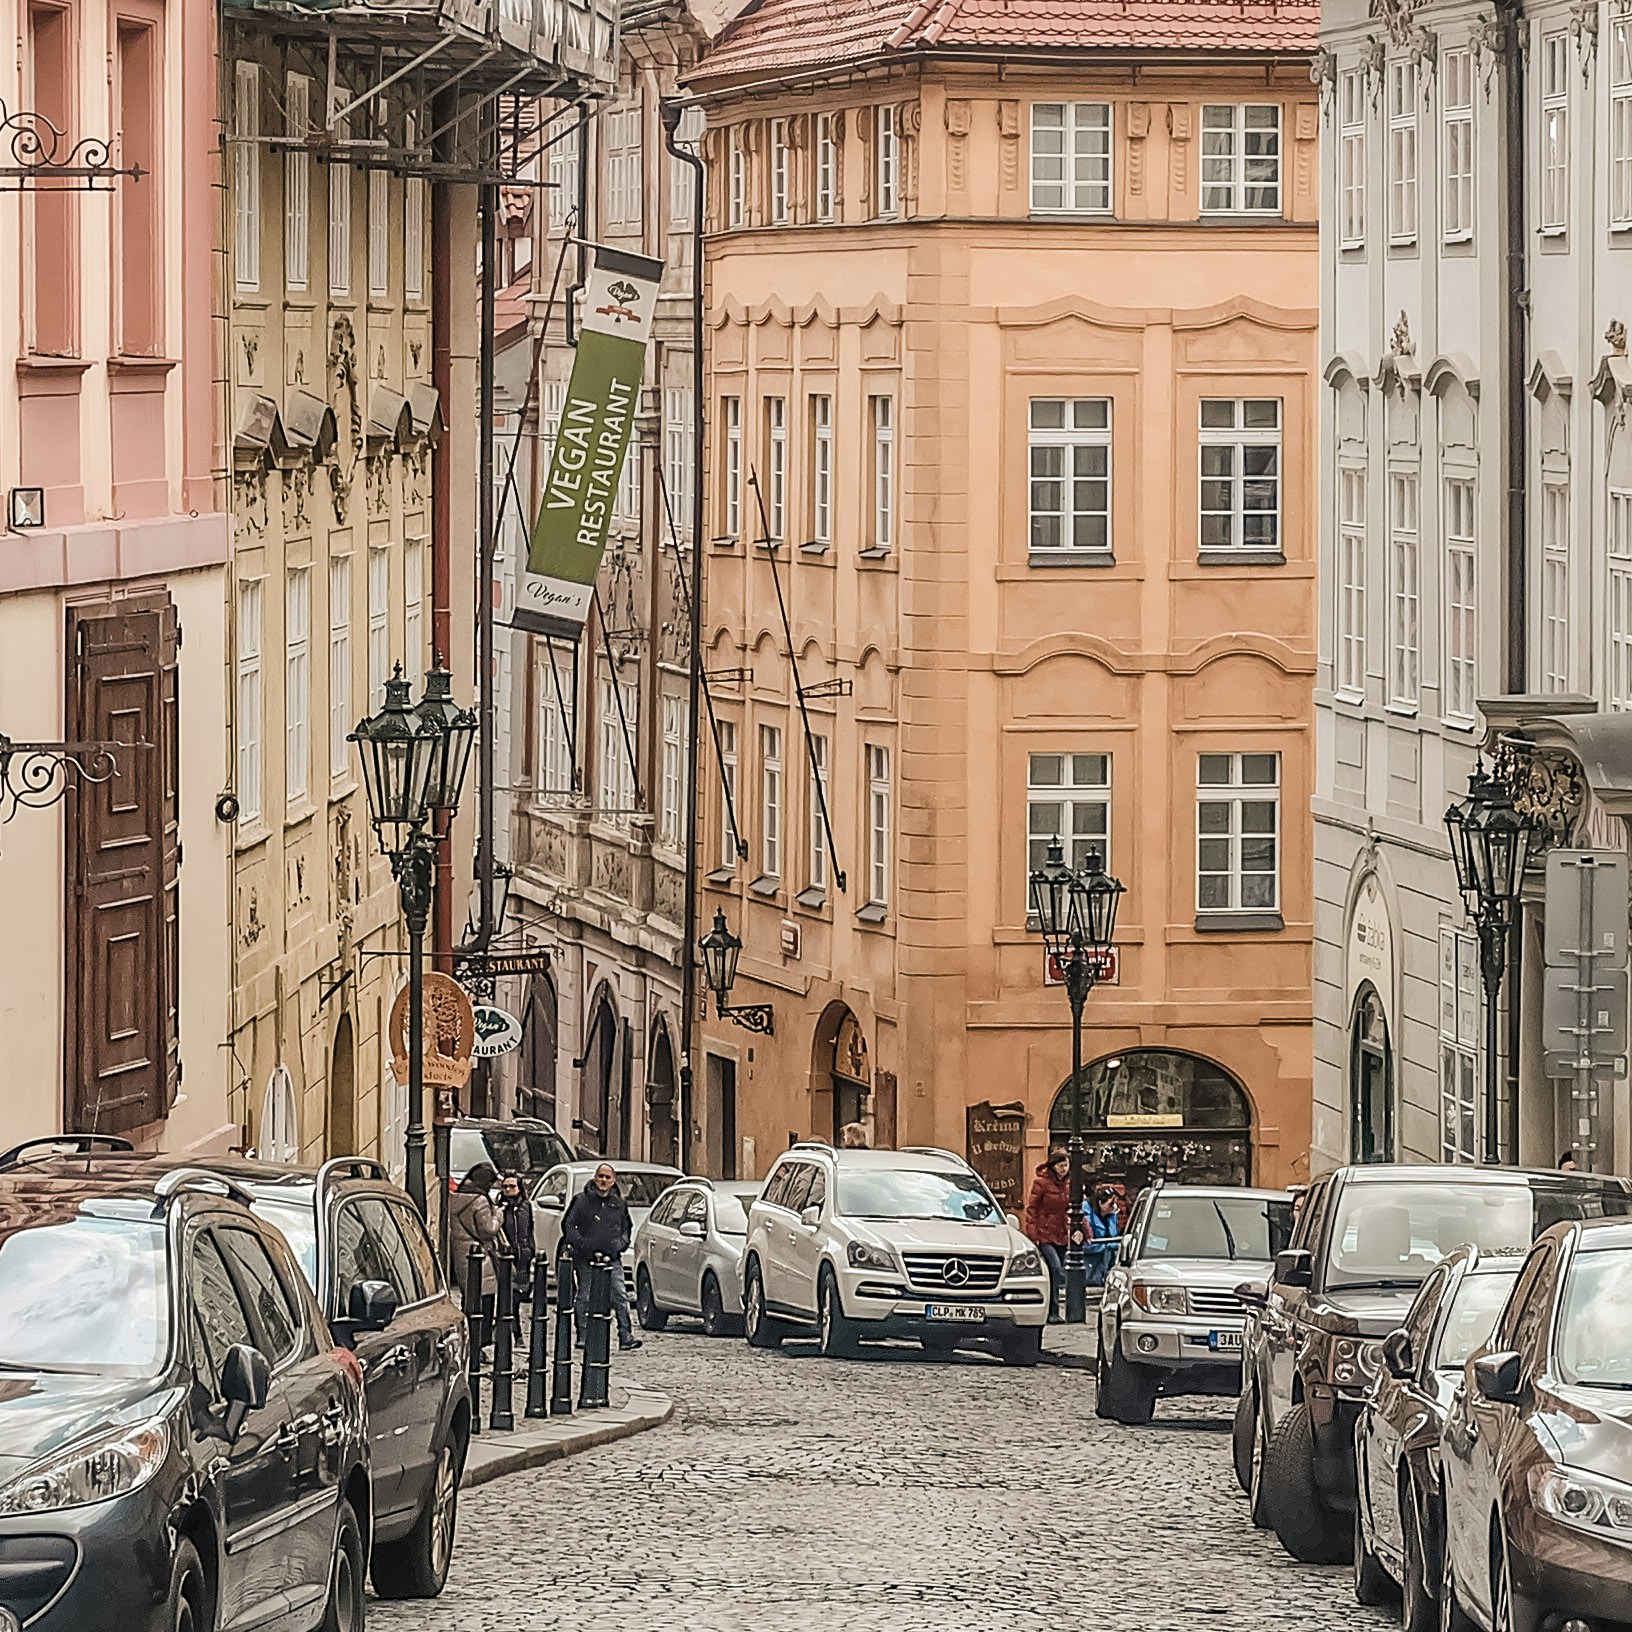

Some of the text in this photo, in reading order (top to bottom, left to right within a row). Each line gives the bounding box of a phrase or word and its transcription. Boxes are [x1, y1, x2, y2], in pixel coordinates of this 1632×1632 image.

[547, 398, 599, 511] VEGAN
[576, 376, 633, 548] RESTAURANT
[487, 957, 546, 973] STAURANT
[473, 1035, 519, 1056] AURANT
[1220, 1333, 1242, 1346] 3AU
